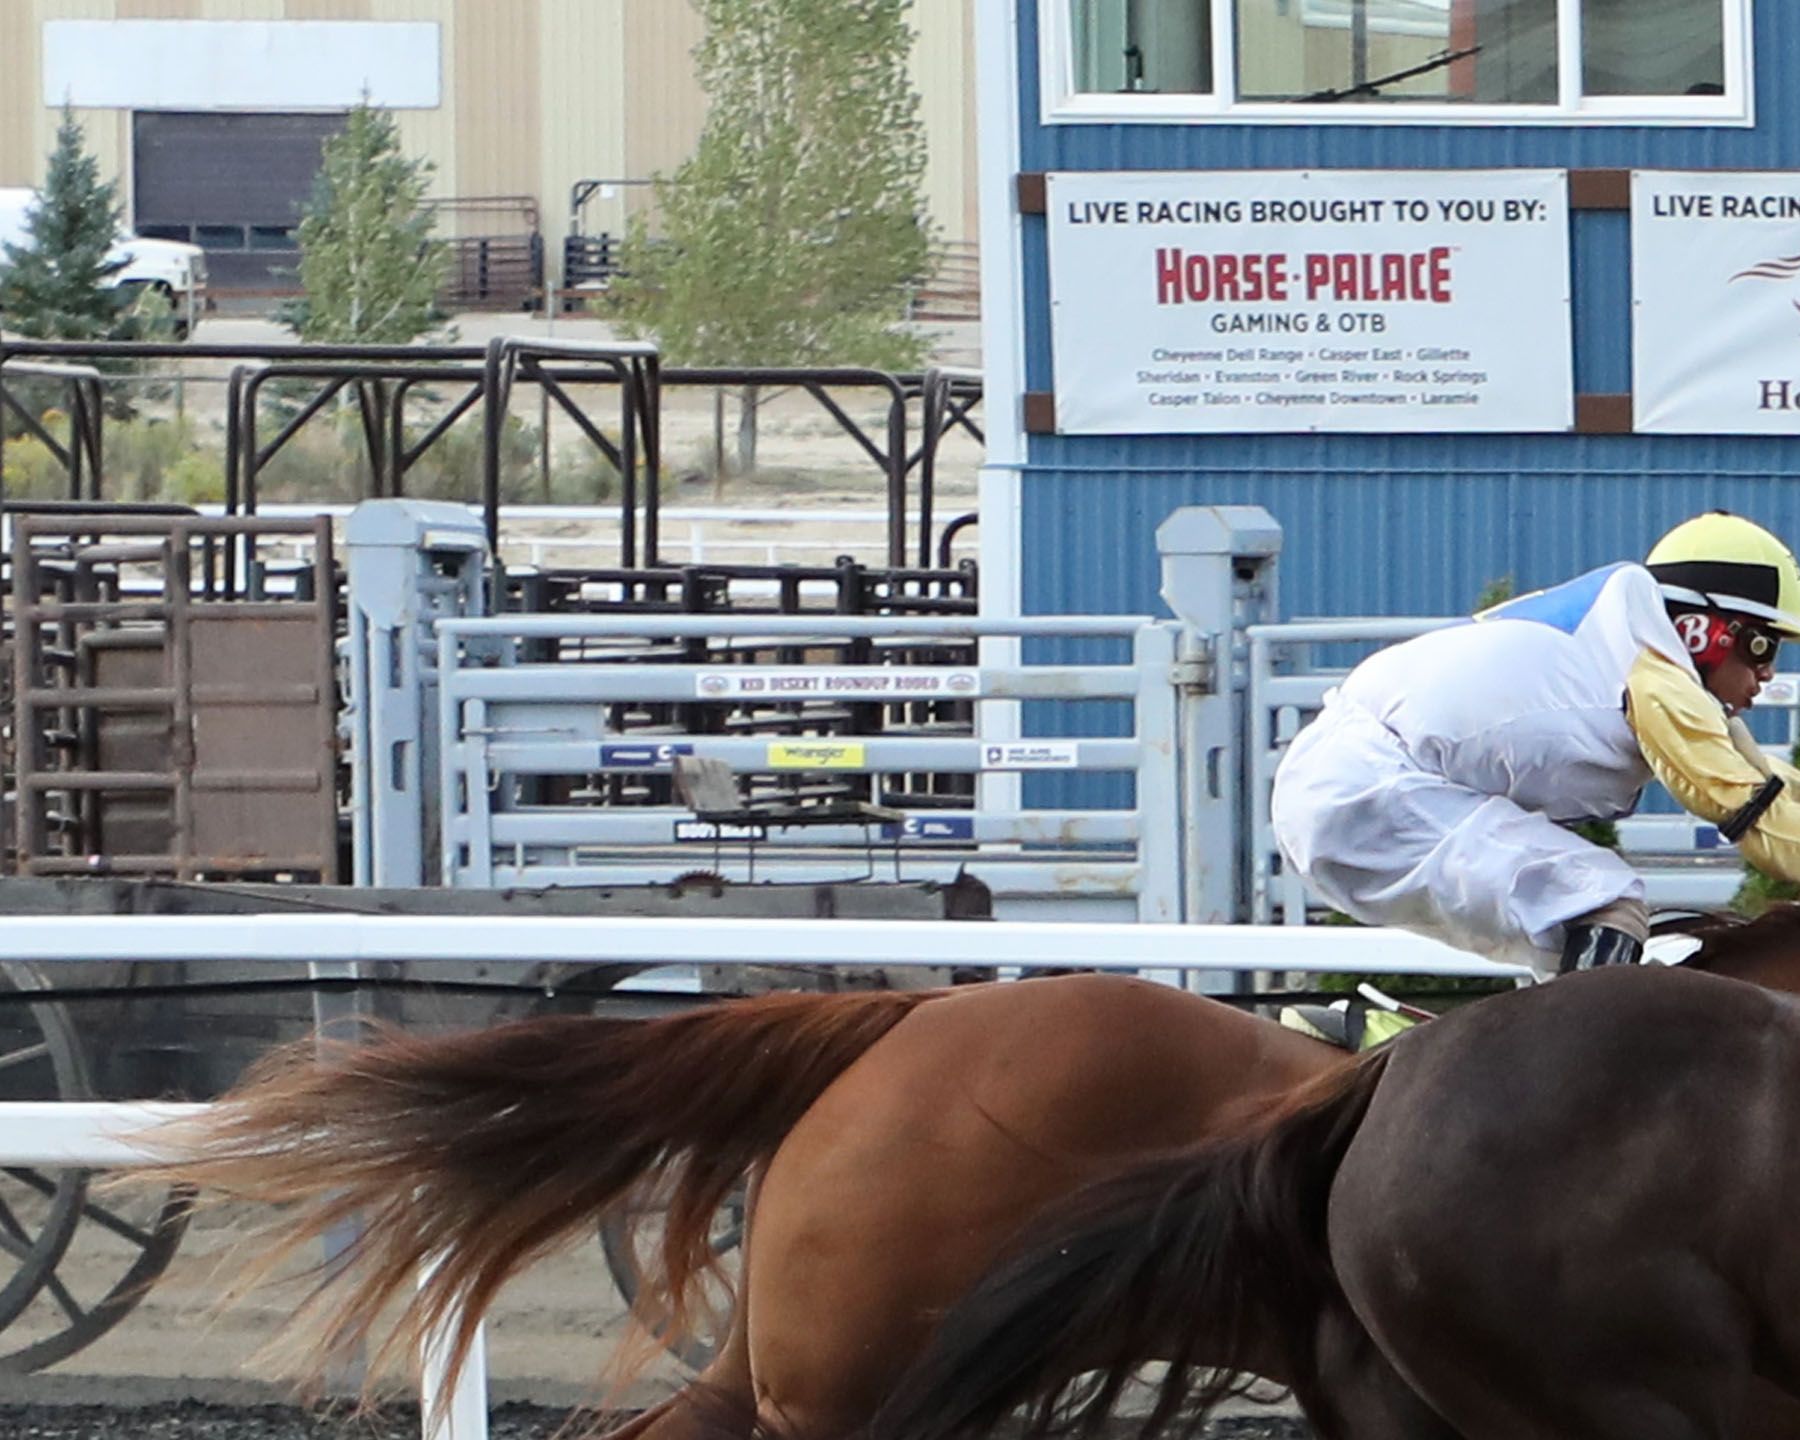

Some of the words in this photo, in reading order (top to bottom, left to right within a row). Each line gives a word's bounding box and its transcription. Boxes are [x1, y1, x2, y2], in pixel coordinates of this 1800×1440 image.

[1068, 202, 1129, 224] LIVE
[1137, 201, 1242, 223] RACING
[1251, 200, 1384, 223] BROUGHT
[1393, 200, 1430, 222] TO
[1437, 199, 1495, 222] YOU
[1503, 199, 1547, 222] BY:
[1653, 195, 1713, 217] LIVE
[1156, 248, 1288, 305] HORSE
[1306, 247, 1452, 304] PALACE
[1211, 313, 1308, 334] GAMING
[1316, 313, 1331, 333] &
[1338, 312, 1386, 333] OTB
[1152, 349, 1223, 364] Cheyenne
